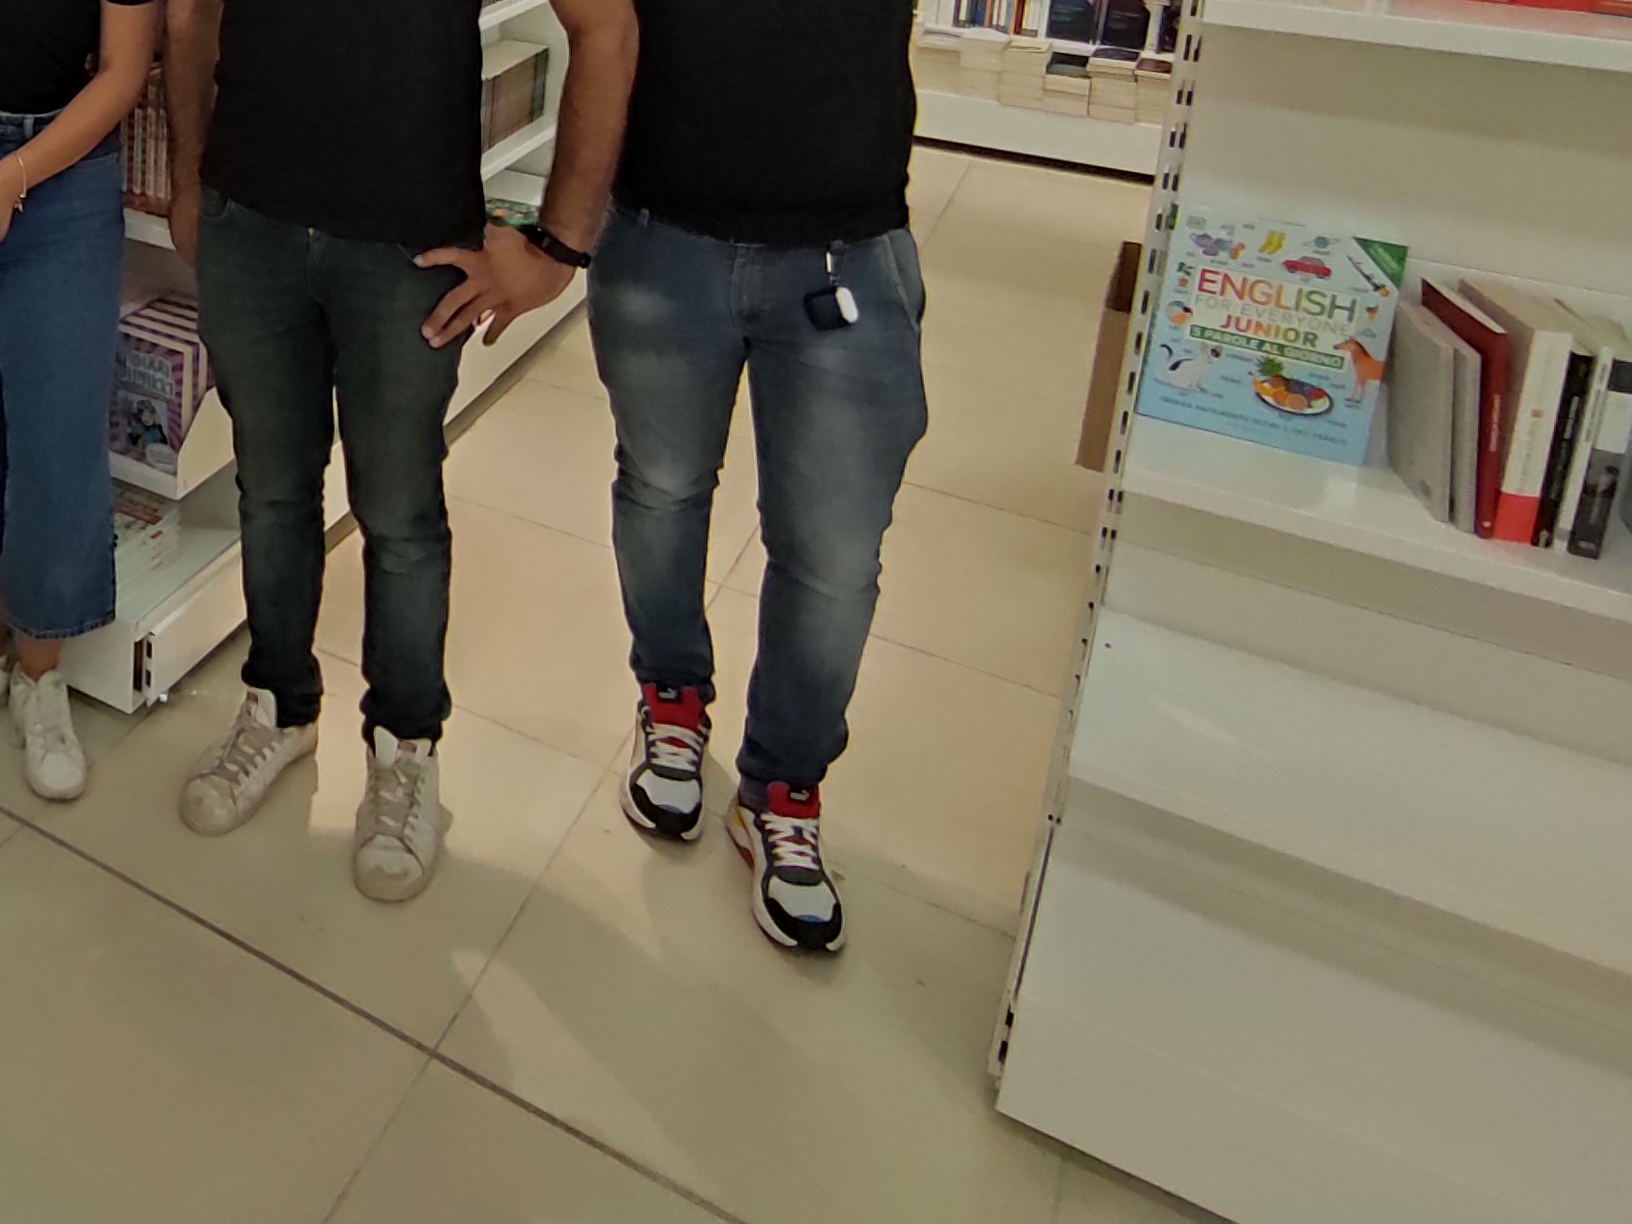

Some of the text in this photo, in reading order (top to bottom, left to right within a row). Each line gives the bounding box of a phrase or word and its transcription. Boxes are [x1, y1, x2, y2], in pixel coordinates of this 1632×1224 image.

[1197, 268, 1357, 323] ENGLISH
[1195, 295, 1351, 337] FOR EVERYONE
[1220, 314, 1318, 348] JUNIOR
[1204, 329, 1260, 350] PAROLE
[1262, 340, 1279, 354] AL
[1283, 347, 1342, 368] GIORNO
